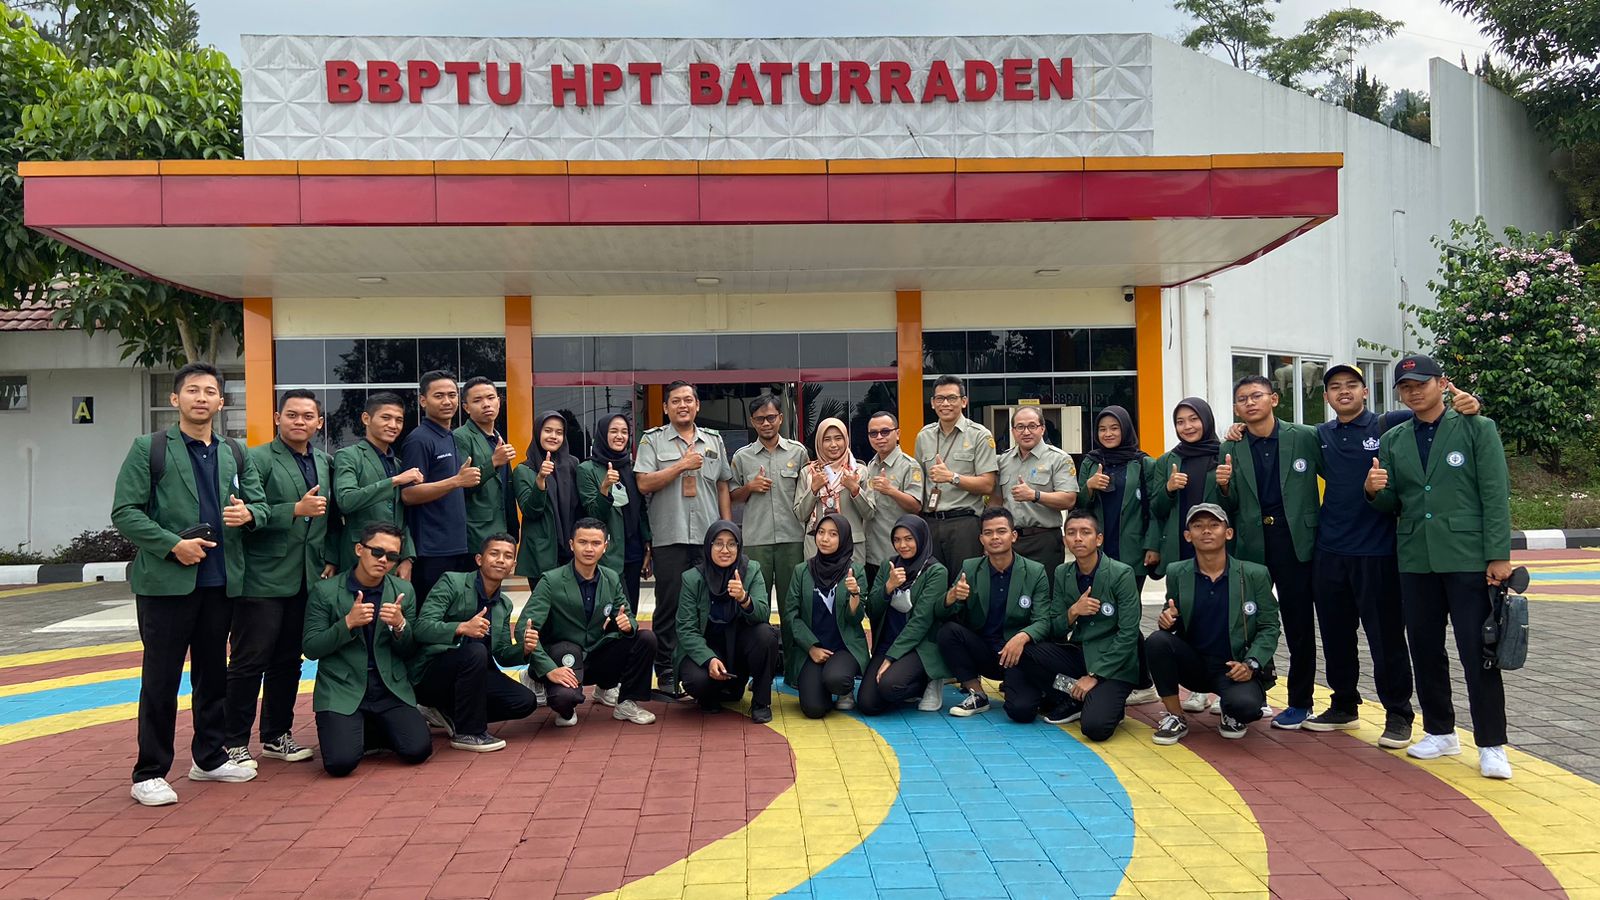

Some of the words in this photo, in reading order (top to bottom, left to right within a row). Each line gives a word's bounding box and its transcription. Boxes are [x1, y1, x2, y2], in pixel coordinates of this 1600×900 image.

[325, 60, 523, 106] BBPTU
[551, 62, 662, 107] HPT
[688, 57, 1074, 106] BATURRADEN
[74, 401, 91, 420] A
